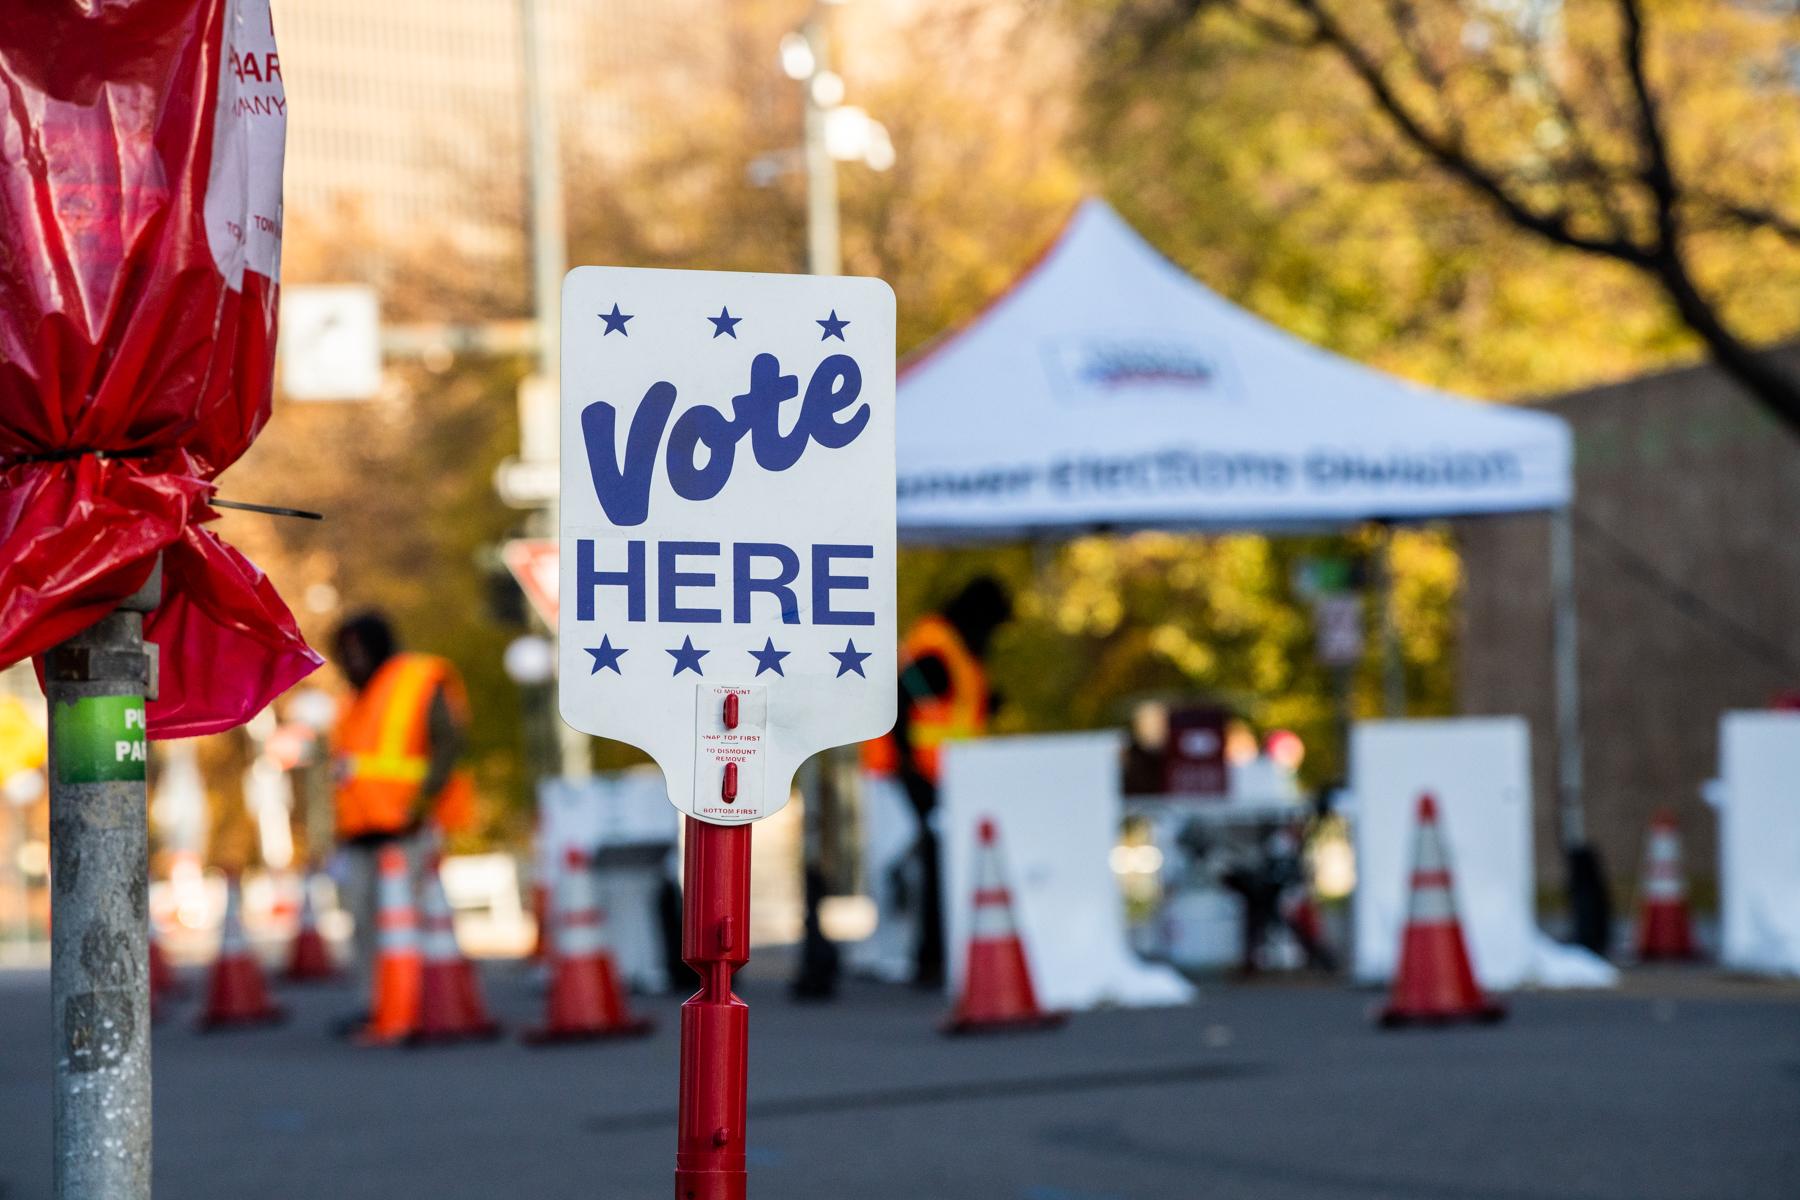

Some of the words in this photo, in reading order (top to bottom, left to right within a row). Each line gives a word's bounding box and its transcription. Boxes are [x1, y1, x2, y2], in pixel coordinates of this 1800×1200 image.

[581, 352, 871, 527] Vote
[576, 538, 875, 627] HERE
[115, 740, 146, 762] PA
